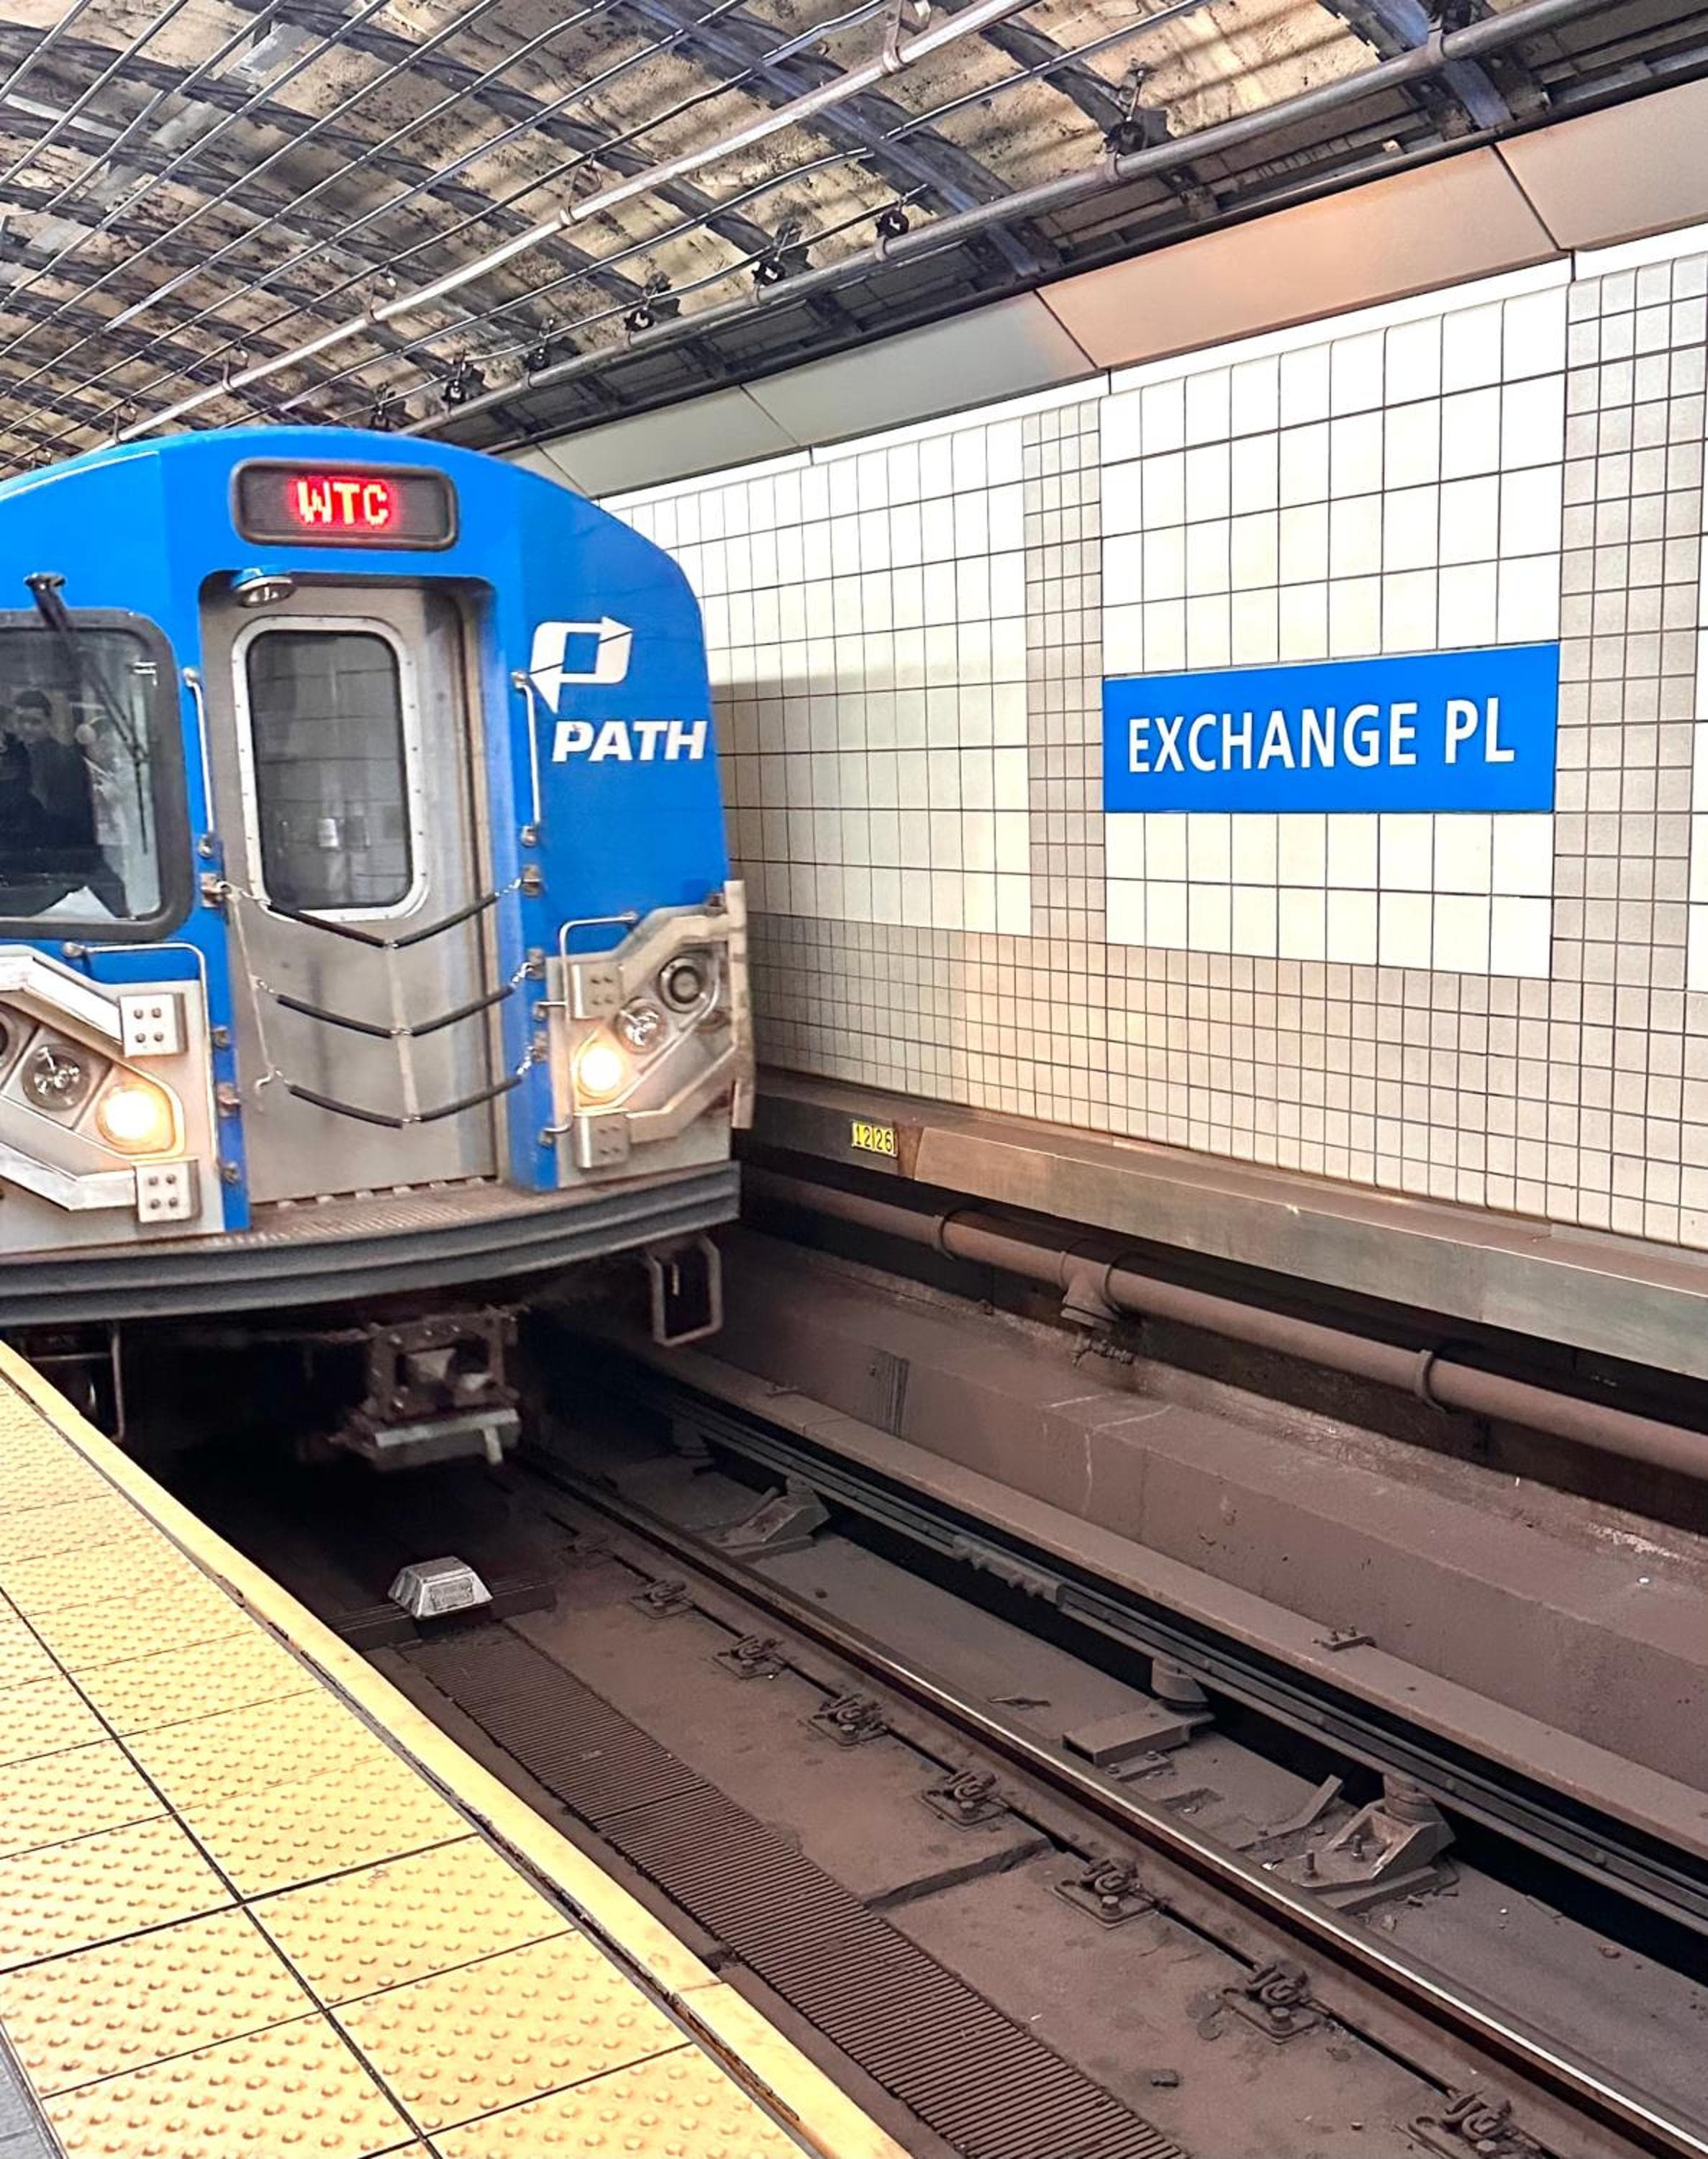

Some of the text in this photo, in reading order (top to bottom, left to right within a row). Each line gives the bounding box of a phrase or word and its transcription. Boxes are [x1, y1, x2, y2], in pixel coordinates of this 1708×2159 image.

[296, 481, 389, 526] WTC
[552, 720, 708, 762] PATH
[1128, 697, 1515, 773] EXCHANGE PL
